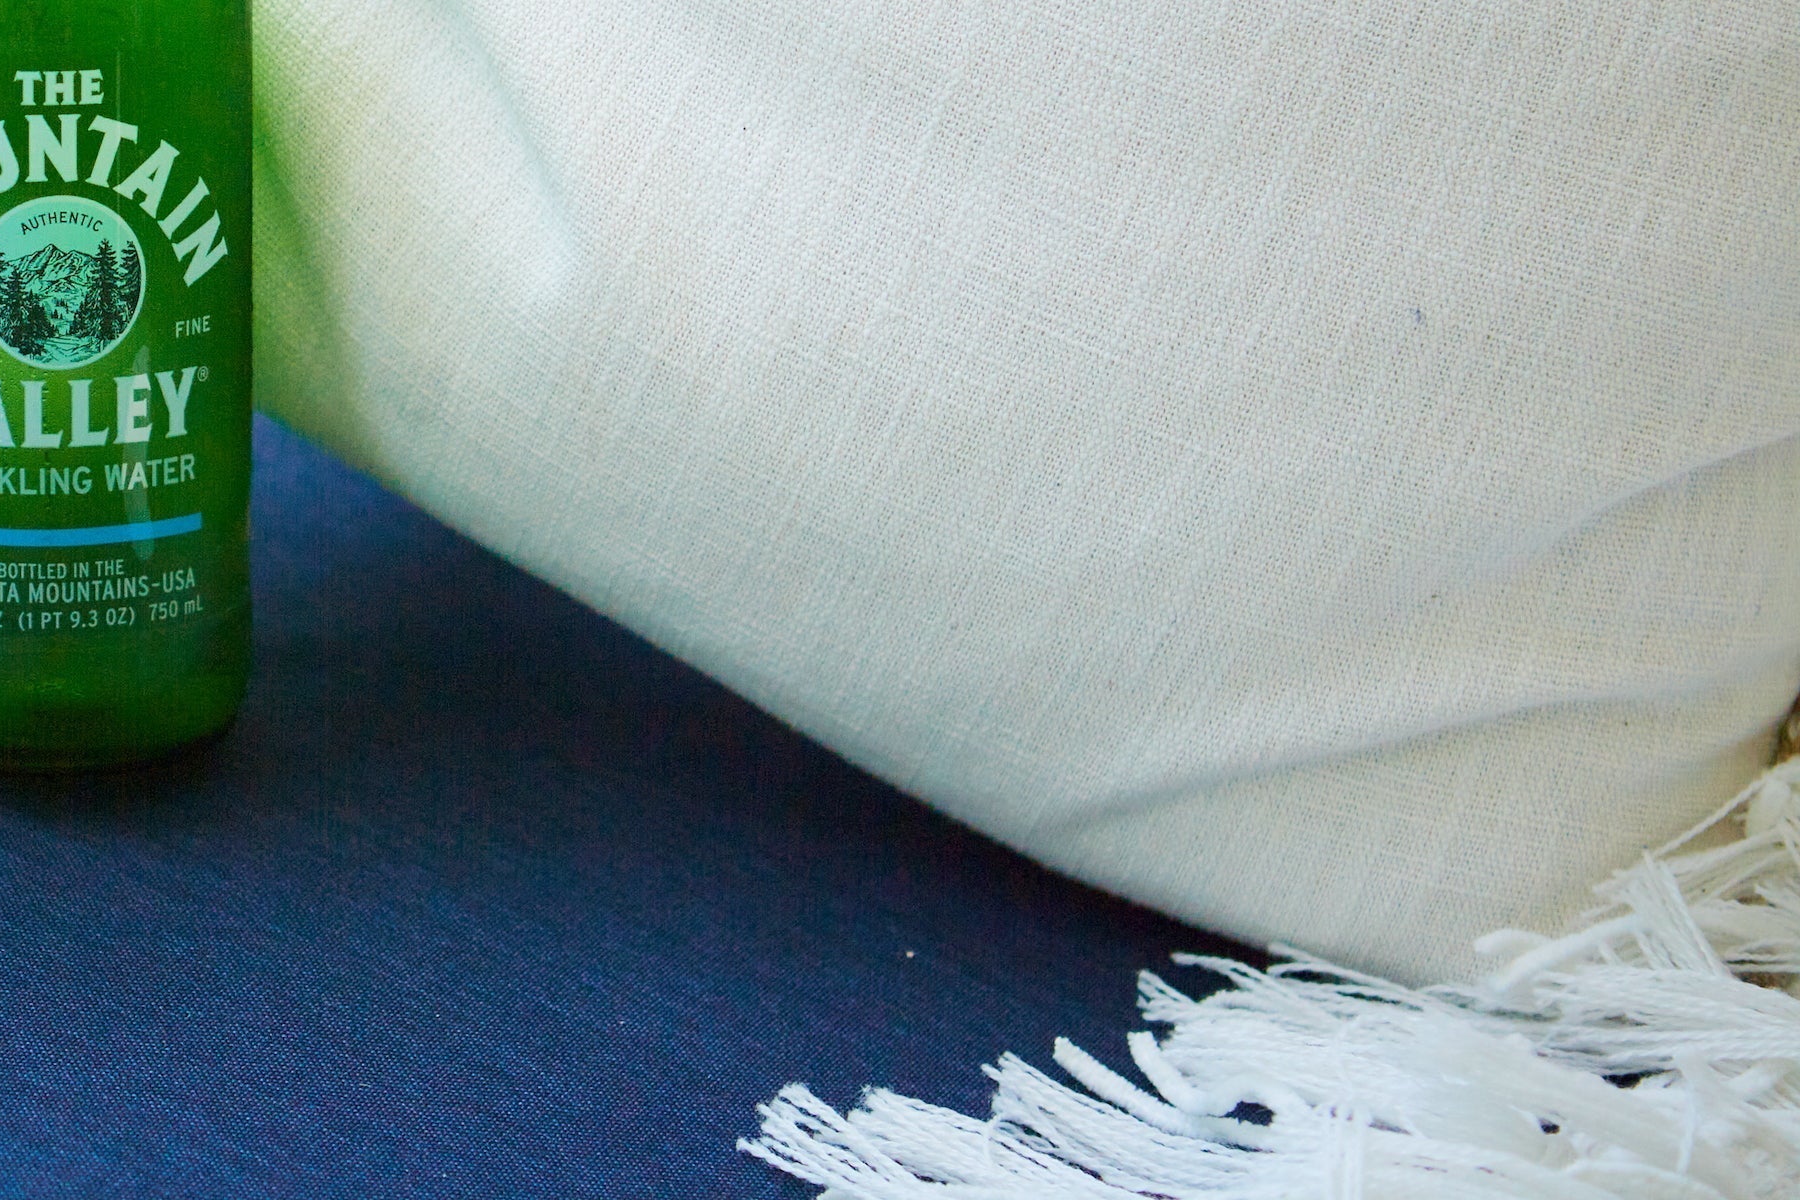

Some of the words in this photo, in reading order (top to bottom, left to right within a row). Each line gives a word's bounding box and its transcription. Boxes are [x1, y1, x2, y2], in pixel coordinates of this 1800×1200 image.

[14, 69, 104, 106] THE
[20, 211, 103, 235] AUTHENTIC
[175, 315, 211, 338] FINE
[105, 453, 196, 491] WATER
[73, 562, 90, 578] IN
[95, 559, 125, 577] THE
[18, 612, 33, 631] (1
[40, 612, 62, 630] PT
[70, 611, 98, 629] 9.3
[105, 607, 136, 628] OZ)
[149, 601, 179, 621] 750
[184, 596, 204, 613] mL
